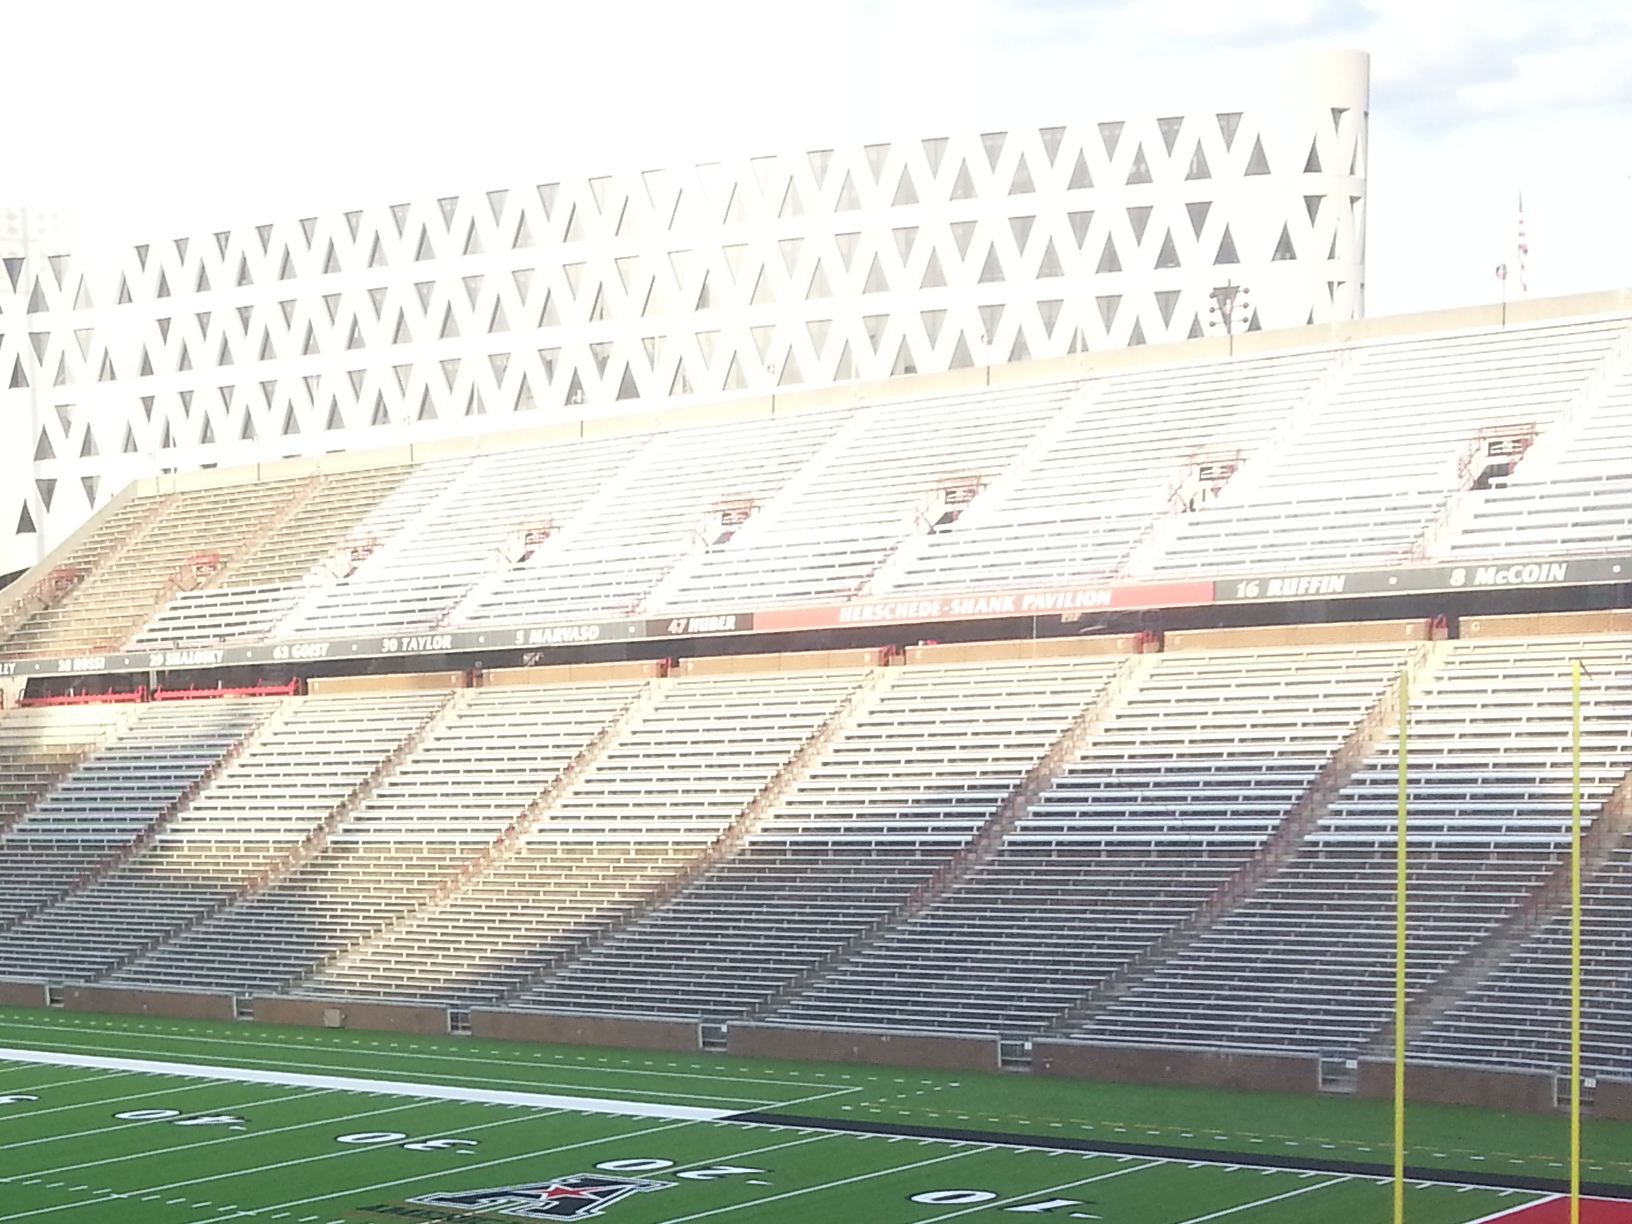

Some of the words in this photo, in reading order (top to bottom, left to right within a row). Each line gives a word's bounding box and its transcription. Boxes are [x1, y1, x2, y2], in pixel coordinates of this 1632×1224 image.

[1449, 567, 1465, 586] 8
[1473, 563, 1568, 586] McCOIN
[1236, 581, 1260, 598] 16
[1266, 575, 1347, 597] RUFFIN
[838, 596, 1016, 623] HERSCHEDE-SHANK
[1021, 589, 1113, 611] PAVILION
[668, 619, 687, 634] 47
[688, 616, 736, 633] HUBER
[381, 638, 397, 652] 30
[401, 635, 452, 651] TAYLOR
